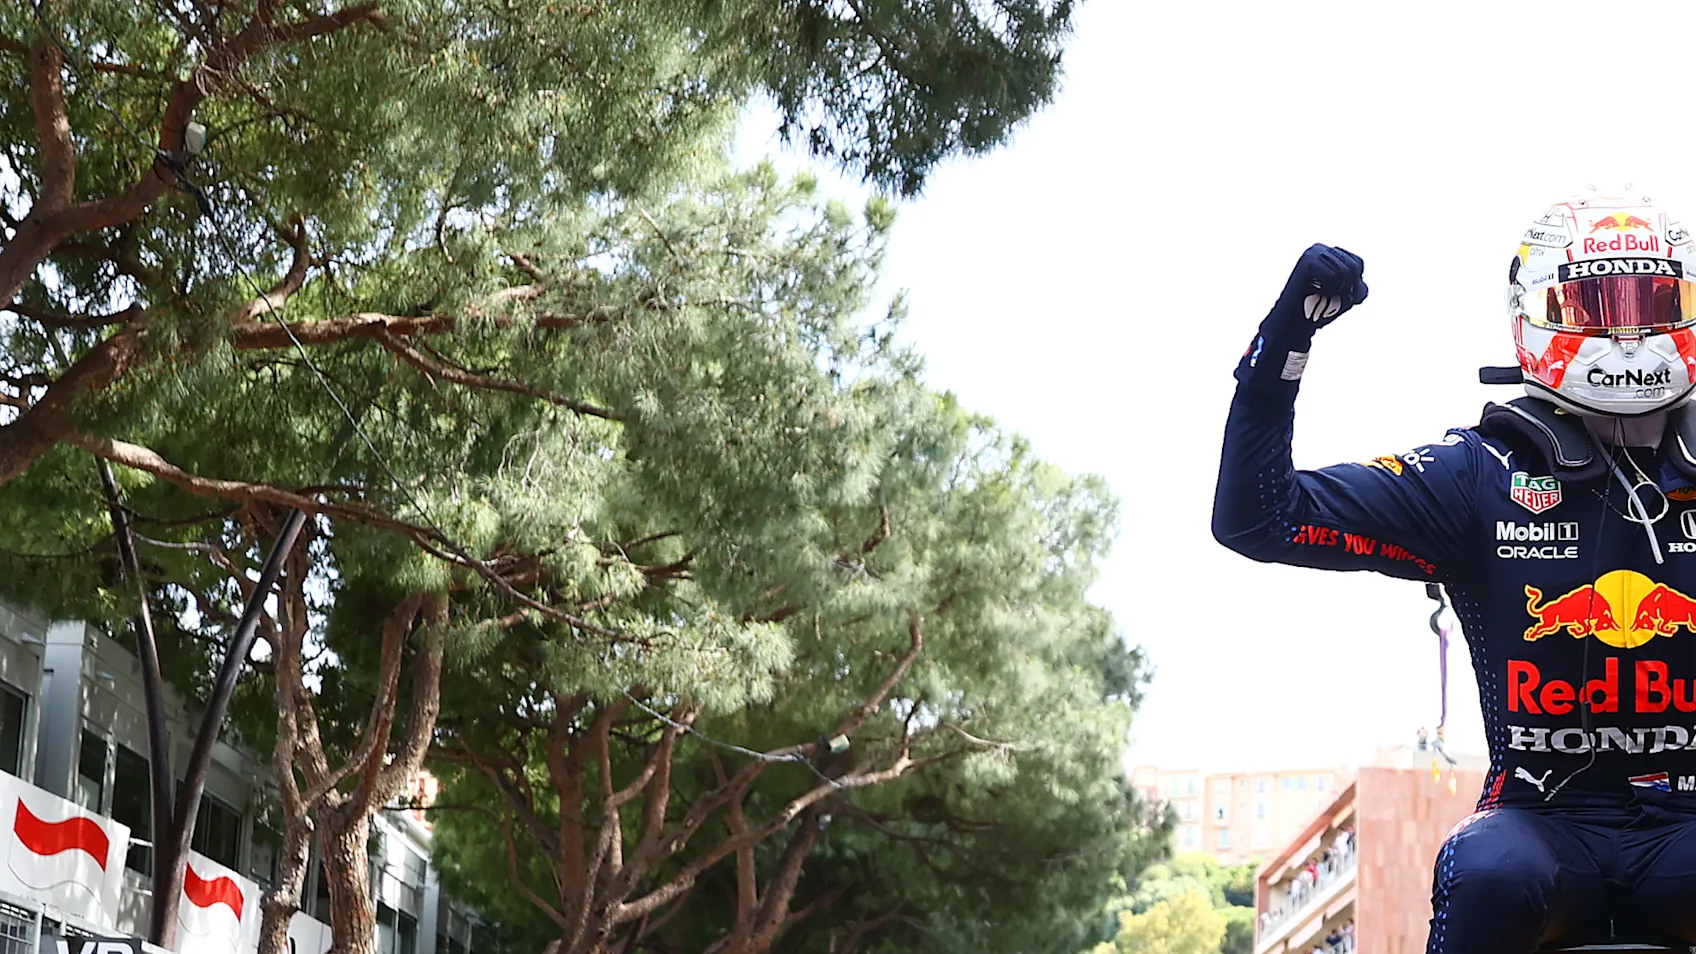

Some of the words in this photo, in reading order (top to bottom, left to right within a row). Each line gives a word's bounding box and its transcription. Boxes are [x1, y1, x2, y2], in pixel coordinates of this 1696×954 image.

[1583, 234, 1622, 255] Red
[1625, 235, 1659, 252] Bull
[1566, 259, 1677, 279] HONDA
[1587, 368, 1671, 387] CarNext
[1633, 387, 1666, 399] .com
[1514, 474, 1558, 491] TAG
[1513, 488, 1559, 511] HEUER
[1496, 521, 1555, 542] Mobil
[1343, 532, 1377, 555] YOU
[1496, 546, 1578, 560] ORACLE
[1507, 656, 1619, 715] Red
